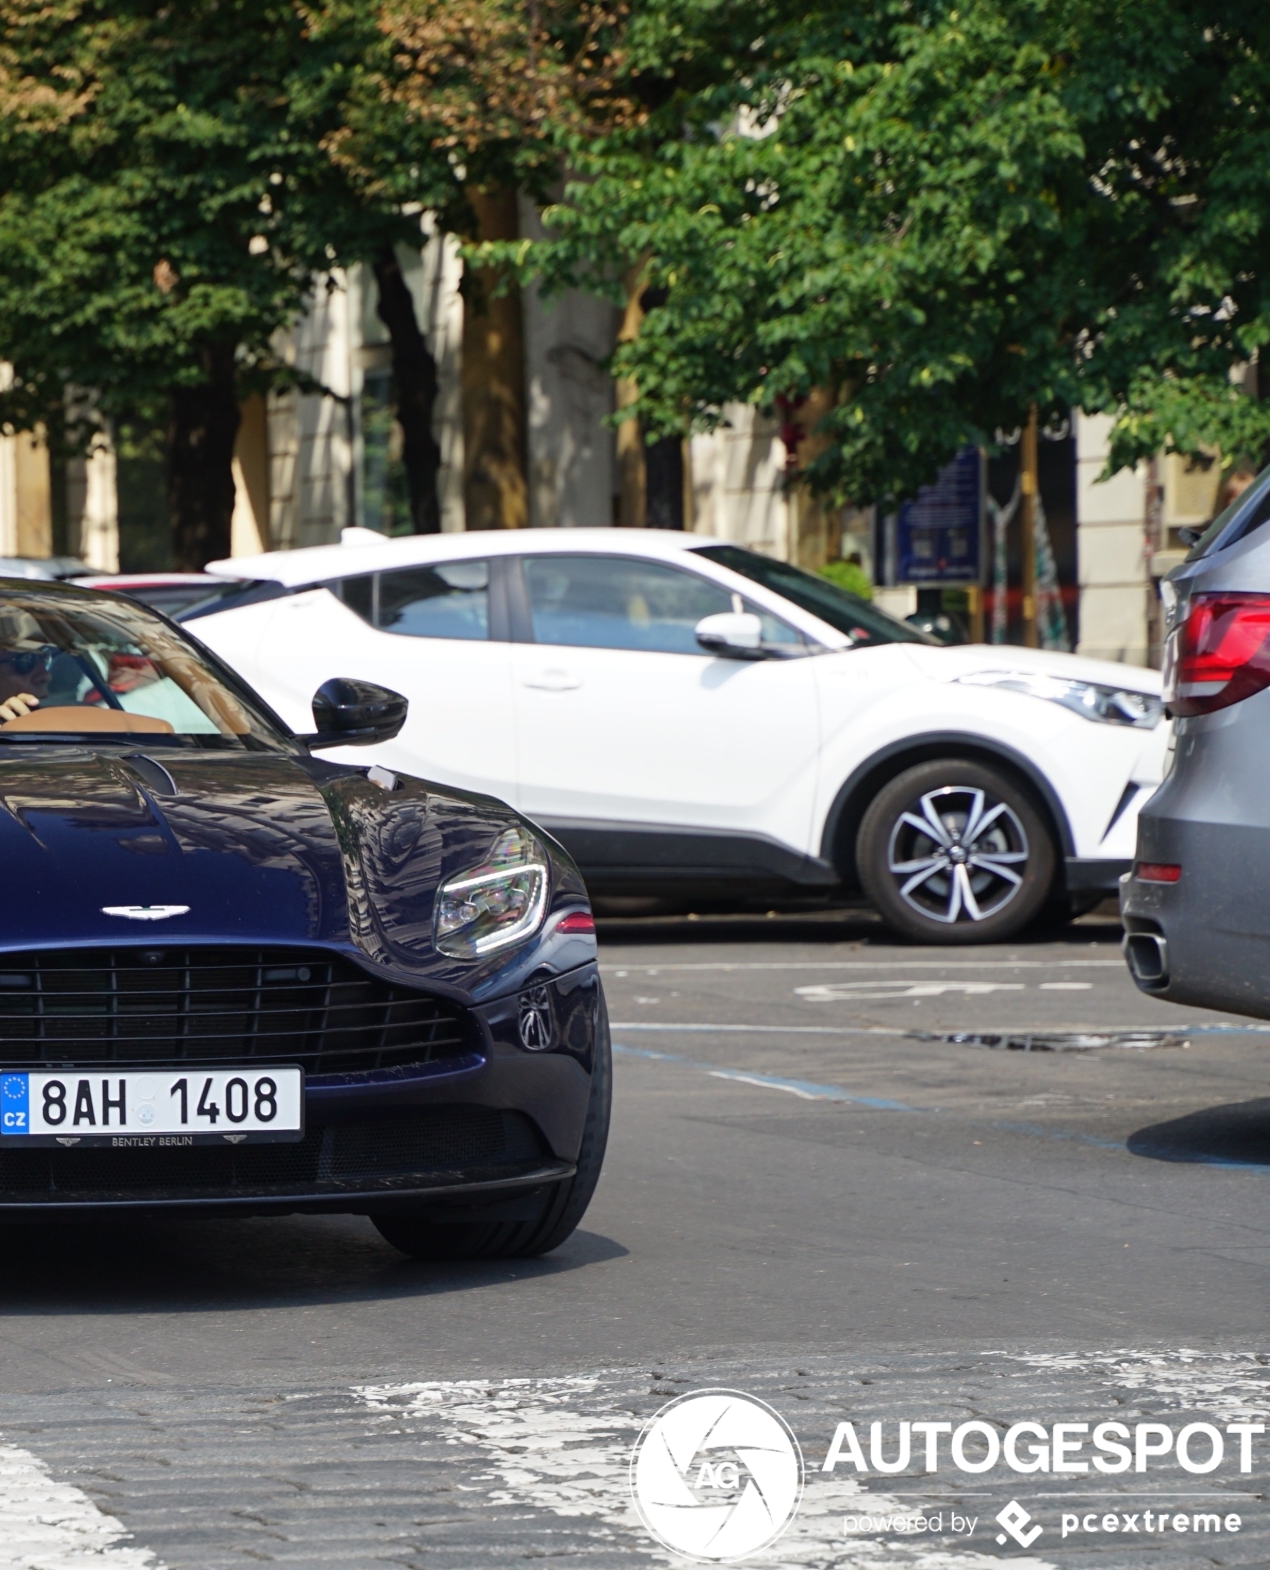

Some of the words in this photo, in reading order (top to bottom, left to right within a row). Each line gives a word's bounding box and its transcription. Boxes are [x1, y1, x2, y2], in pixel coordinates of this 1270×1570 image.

[42, 1078, 127, 1126] 8AH
[170, 1077, 277, 1124] 1408
[3, 1113, 26, 1127] CZ
[112, 1136, 156, 1147] BENTLEY
[159, 1136, 193, 1146] BERLIN
